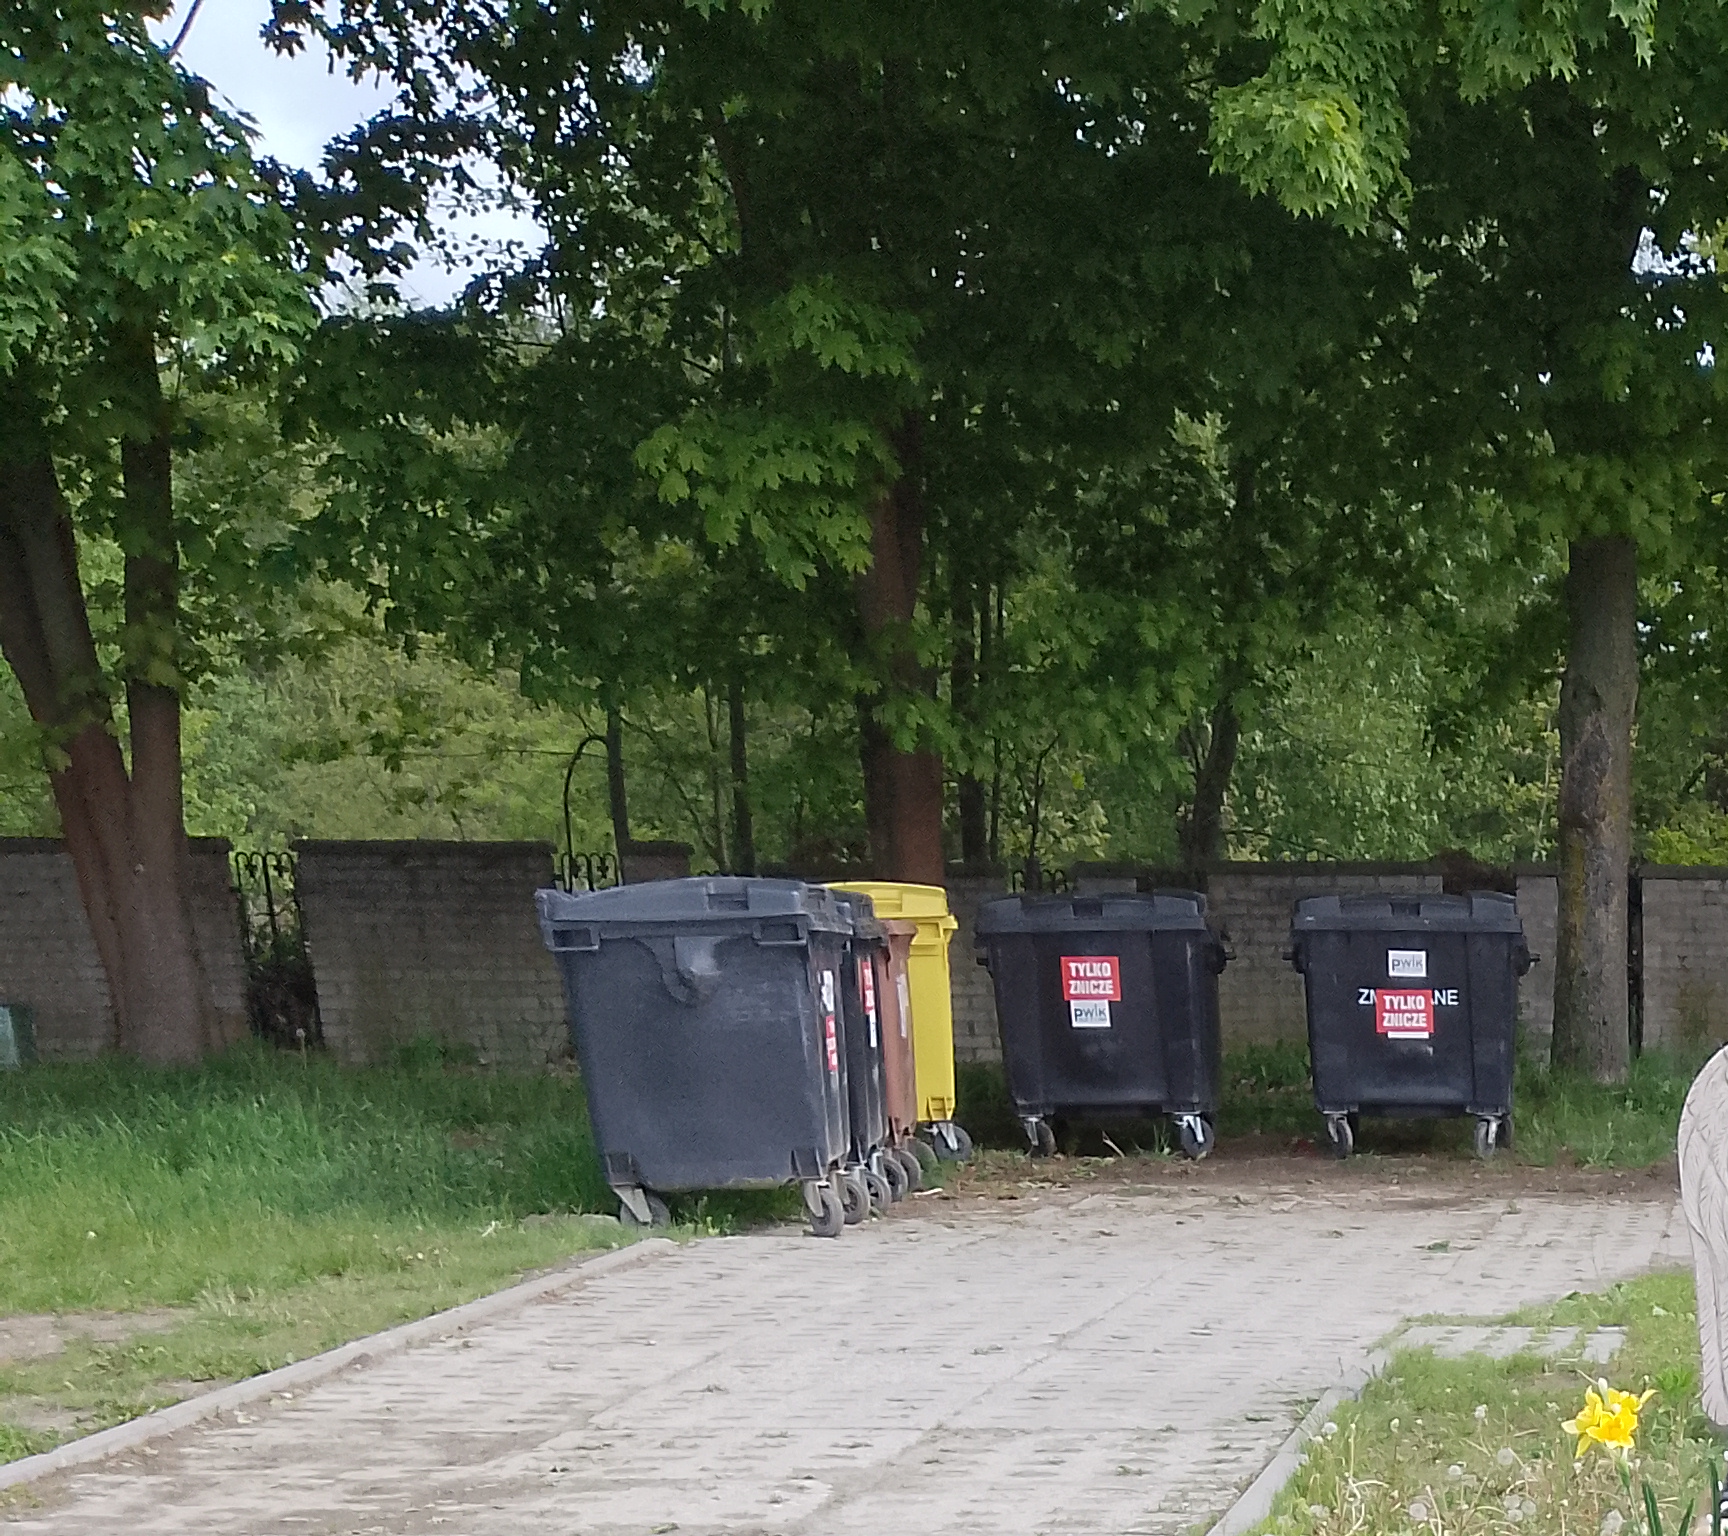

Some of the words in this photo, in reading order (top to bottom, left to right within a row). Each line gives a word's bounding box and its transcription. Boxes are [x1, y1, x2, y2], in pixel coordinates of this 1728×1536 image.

[1068, 962, 1111, 977] TYLKO
[1068, 980, 1114, 994] ZNICZE
[1383, 995, 1425, 1010] TYLKO
[1382, 1013, 1427, 1026] ZNICZE
